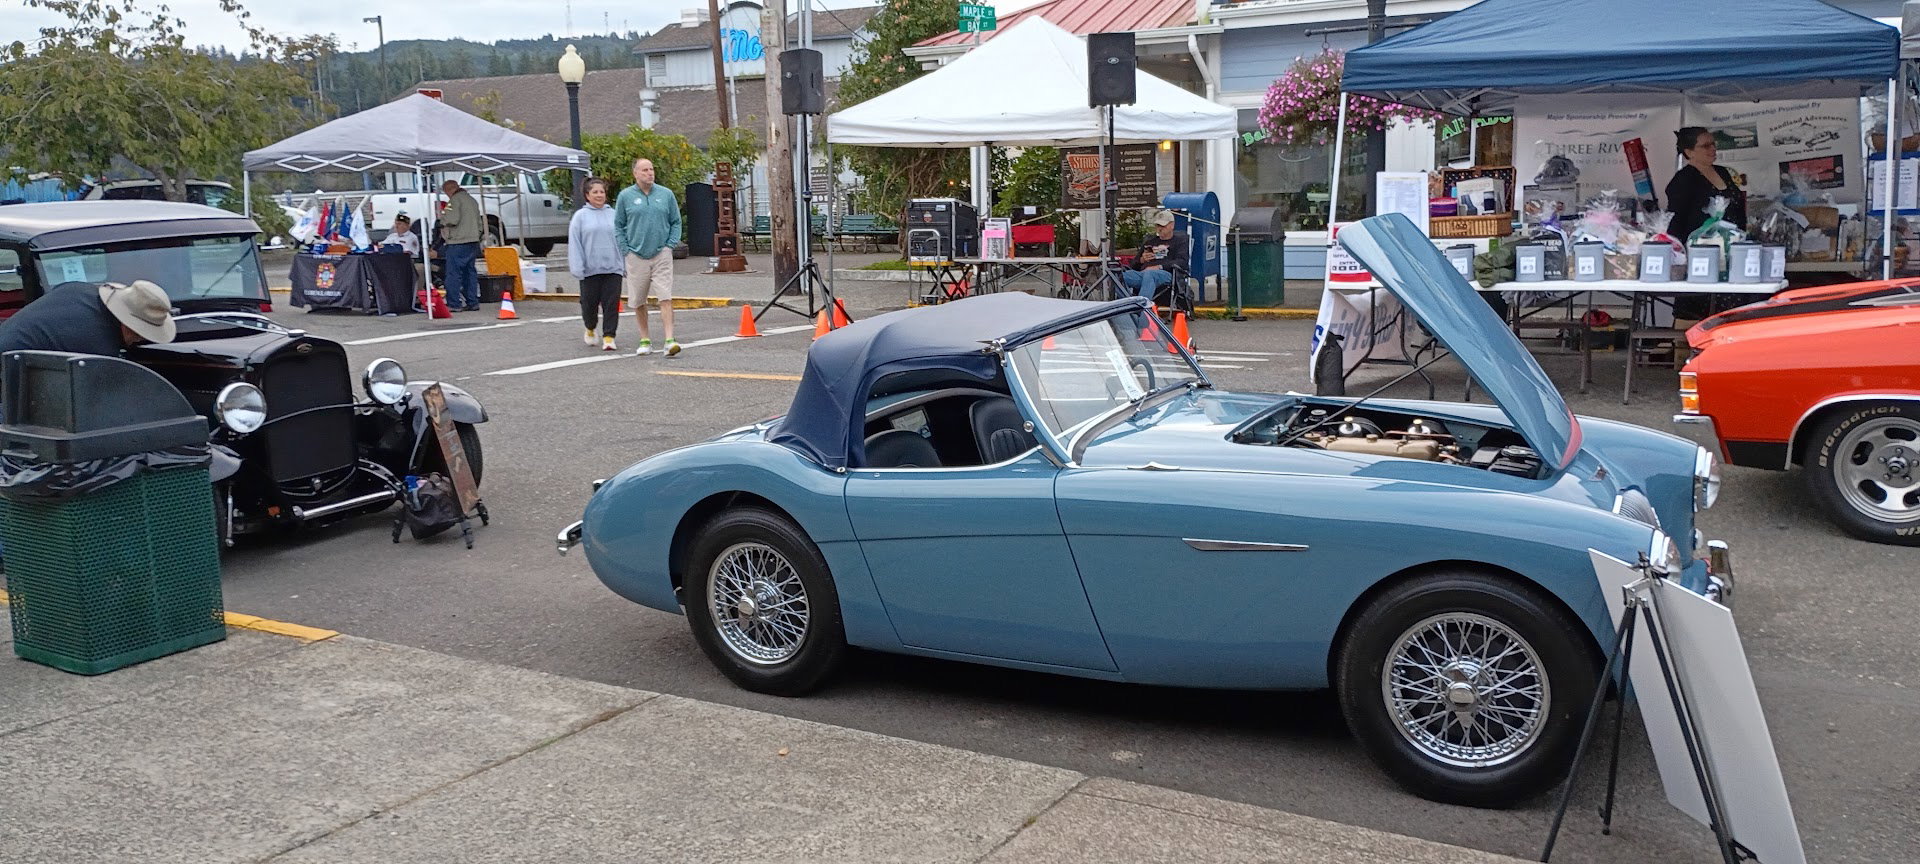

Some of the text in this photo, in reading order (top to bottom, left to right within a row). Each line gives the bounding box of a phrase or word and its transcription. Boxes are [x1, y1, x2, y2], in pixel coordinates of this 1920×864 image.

[963, 6, 985, 17] MAPLE
[967, 22, 980, 31] BAY
[1712, 114, 1730, 122] Major
[1732, 108, 1776, 120] Sponsorship
[1779, 103, 1810, 112] Provided
[1545, 142, 1593, 154] THREE
[1818, 406, 1901, 468] BFGoodrich
